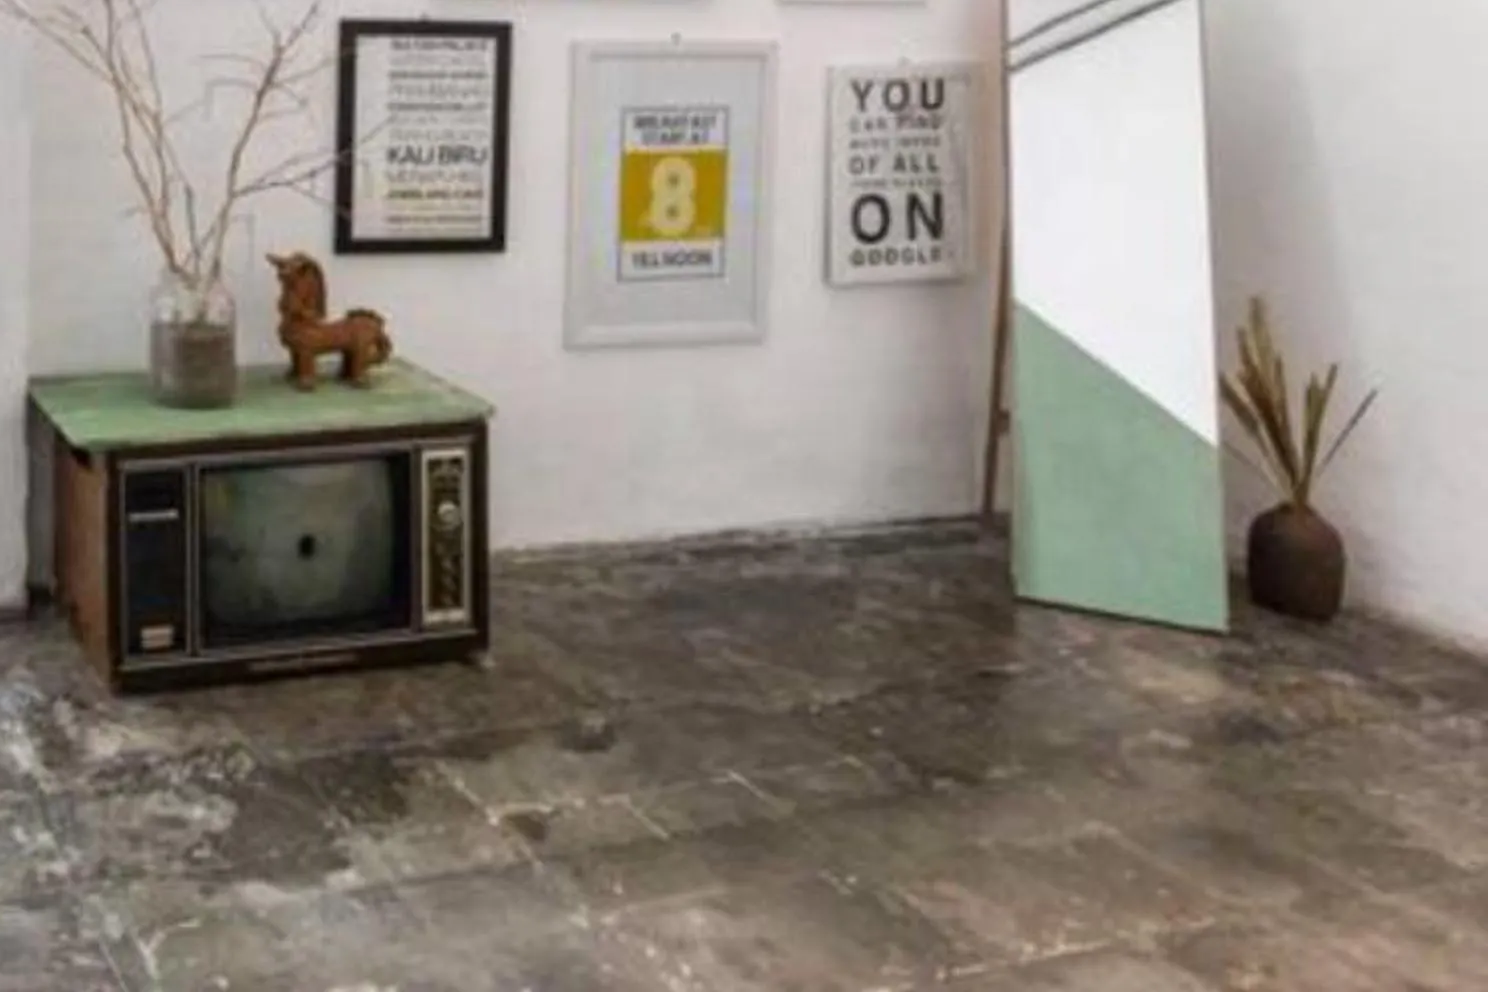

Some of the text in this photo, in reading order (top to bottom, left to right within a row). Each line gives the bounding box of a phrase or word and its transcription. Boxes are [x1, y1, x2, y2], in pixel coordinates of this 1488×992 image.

[849, 78, 945, 113] YOU
[895, 113, 943, 130] FIND
[849, 152, 940, 176] OF ALL
[649, 155, 698, 238] 8
[850, 192, 943, 245] ON
[849, 245, 942, 266] GOOGLE
